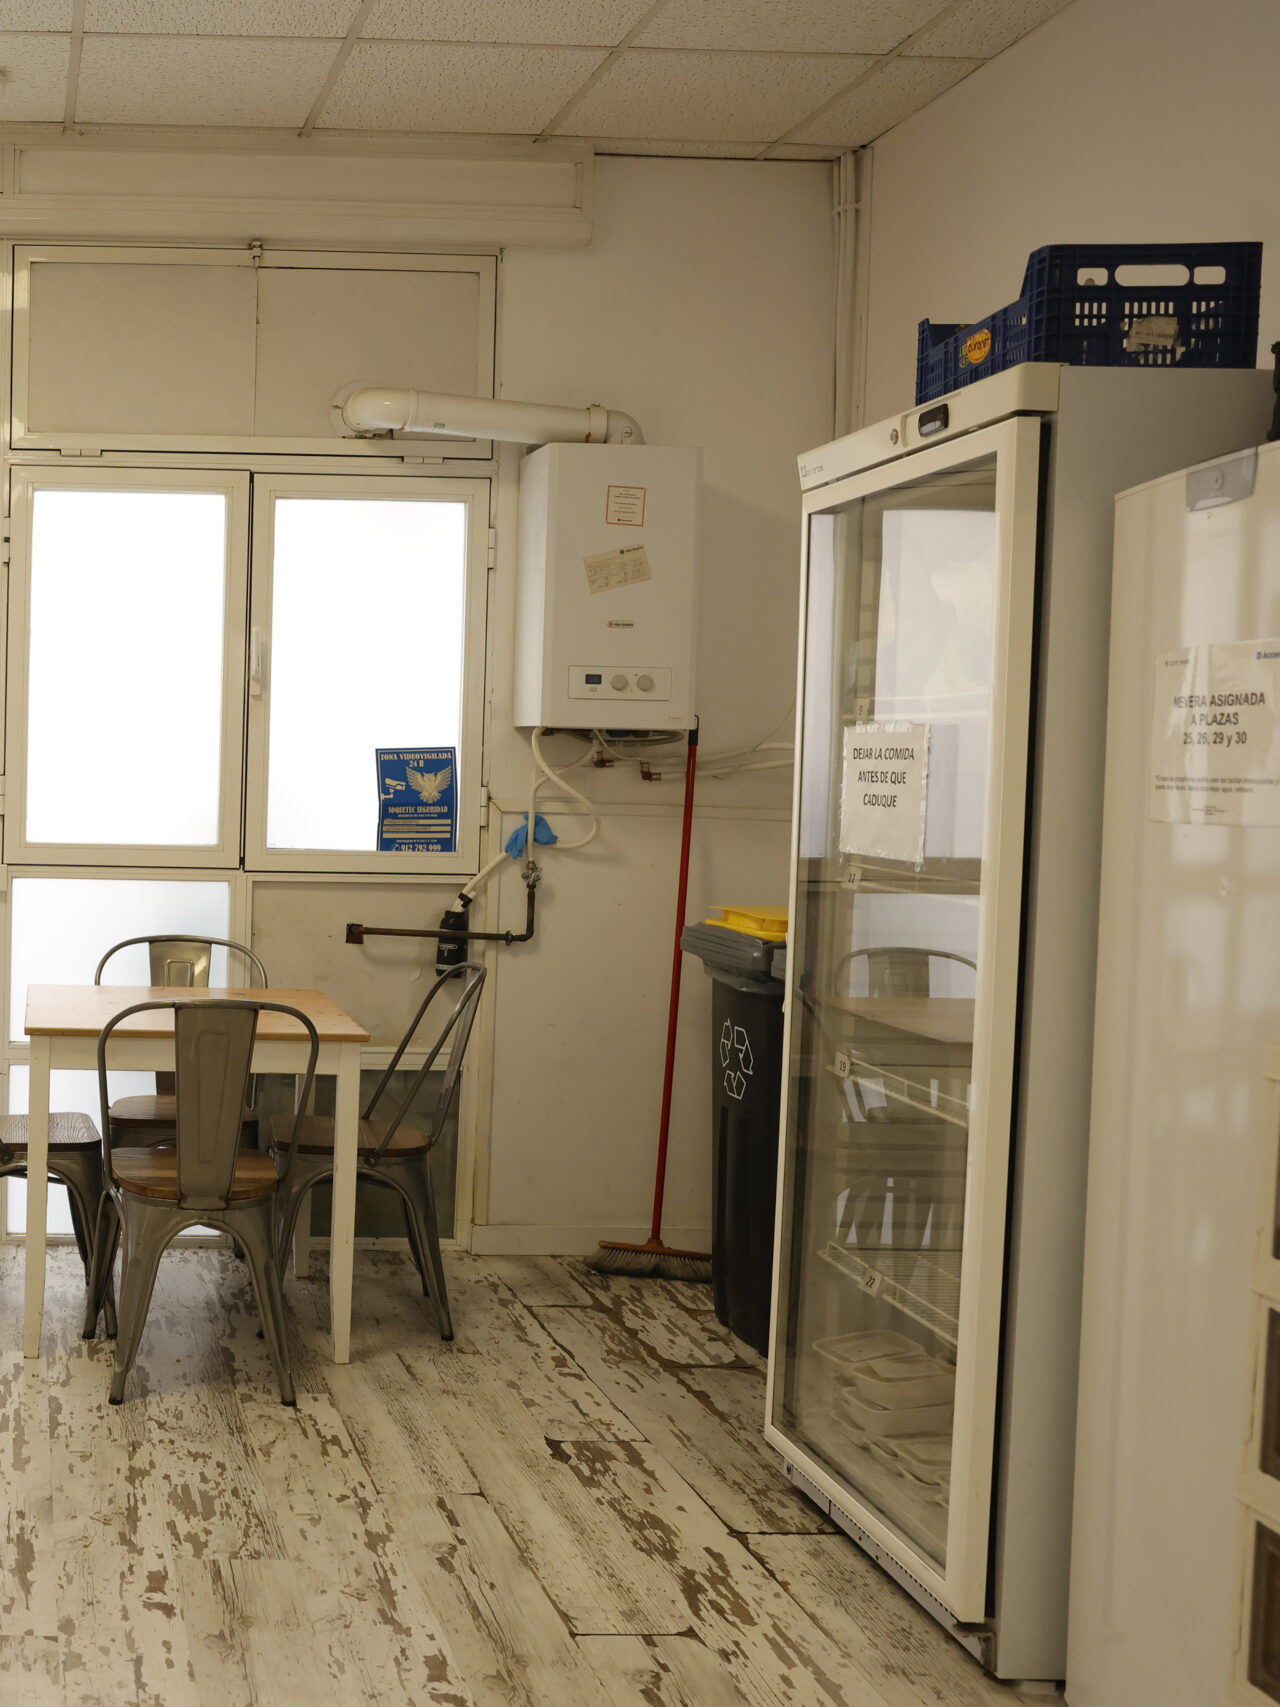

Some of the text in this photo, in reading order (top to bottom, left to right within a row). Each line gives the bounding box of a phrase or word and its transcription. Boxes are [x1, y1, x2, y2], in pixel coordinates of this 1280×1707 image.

[1173, 692, 1266, 709] NEVERA ASIGNADA
[1191, 712, 1239, 726] A PLAZAS
[1183, 732, 1196, 746] 25,
[1213, 731, 1224, 745] 29
[1226, 735, 1233, 747] y
[1235, 731, 1247, 744] 30
[399, 752, 452, 760] VIDEOVIGILADA
[853, 747, 915, 761] DEJAR LA COMIDA
[409, 760, 417, 768] 24
[857, 770, 907, 785] ANTES DE QUE
[863, 793, 898, 808] CADUQUE
[401, 844, 441, 852] 912 792 999
[839, 1060, 847, 1072] 19
[865, 1275, 876, 1289] 22
